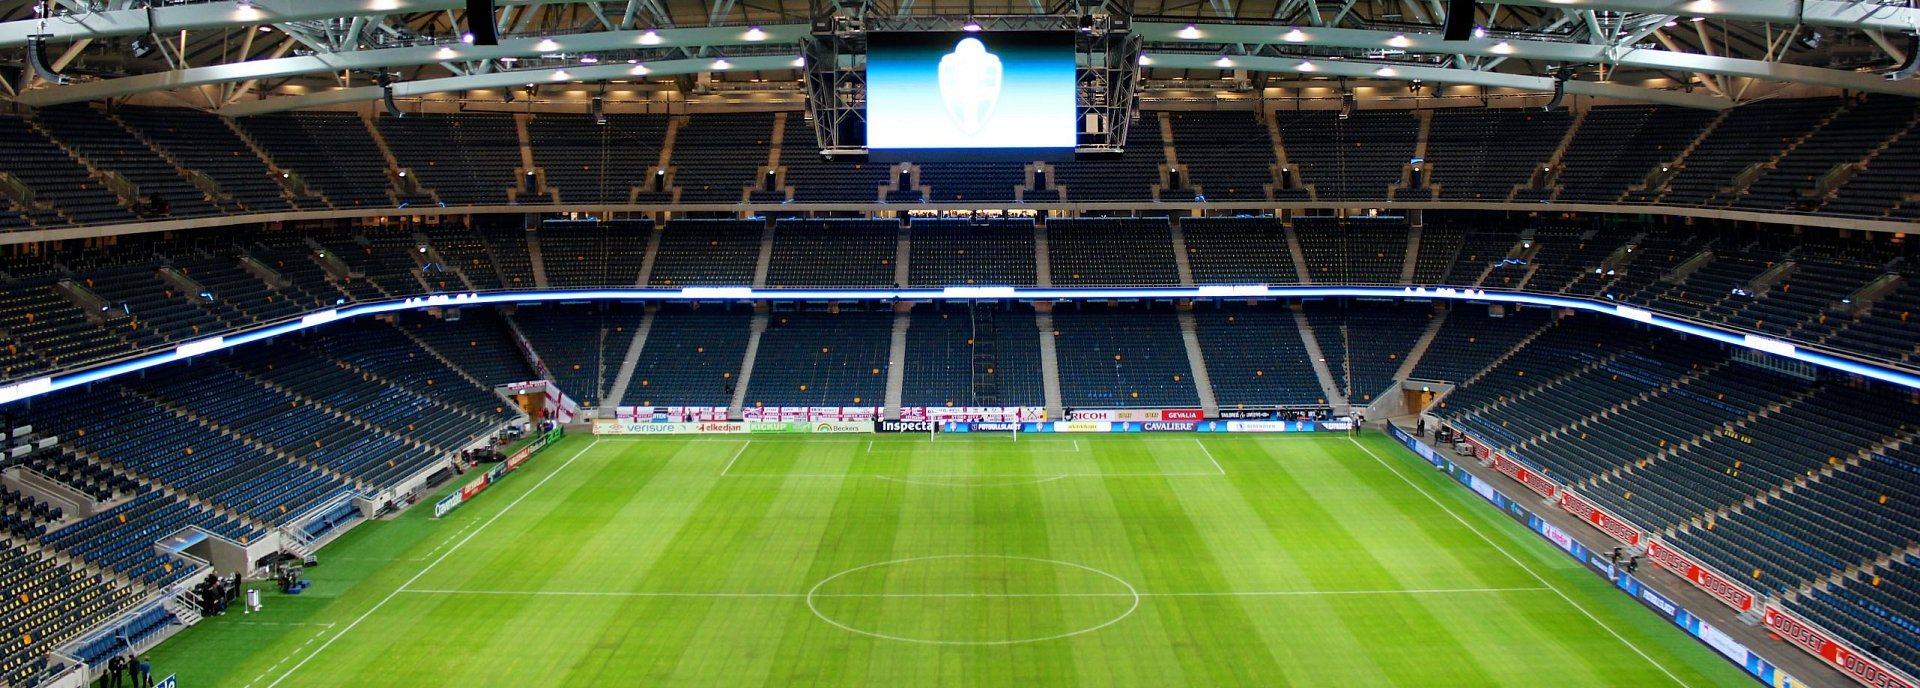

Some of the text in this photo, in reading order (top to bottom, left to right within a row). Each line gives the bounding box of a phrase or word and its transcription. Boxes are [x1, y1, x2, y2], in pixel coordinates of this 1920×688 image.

[628, 423, 674, 432] verisure
[706, 423, 741, 432] elkedjan
[883, 421, 933, 432] Inspecta
[1144, 423, 1193, 431] CAVALIERE
[1654, 547, 1691, 574] ODDSET
[1705, 576, 1747, 607] ODDSET
[1774, 615, 1826, 653] ODDSET
